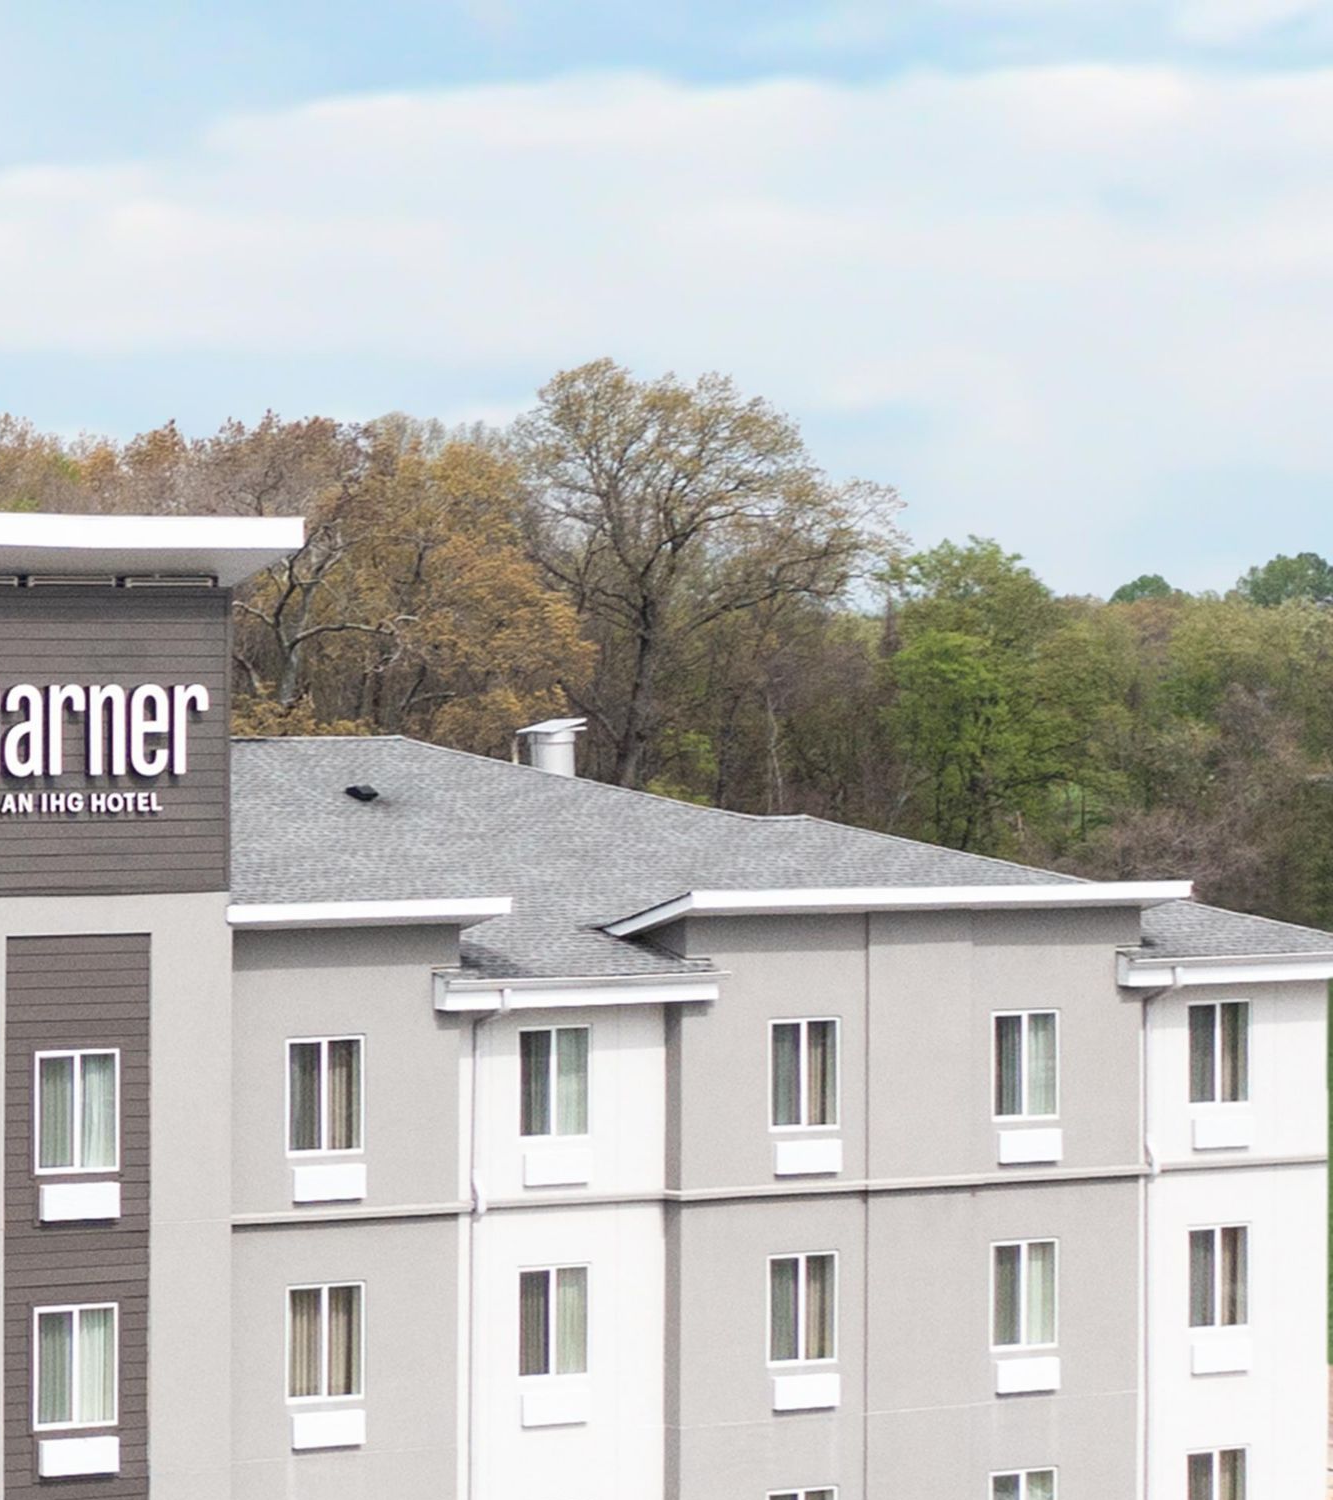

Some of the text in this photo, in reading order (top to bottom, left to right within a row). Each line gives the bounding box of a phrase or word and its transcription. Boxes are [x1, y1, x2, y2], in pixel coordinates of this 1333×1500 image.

[1, 792, 163, 814] AN IHG HOTEL
